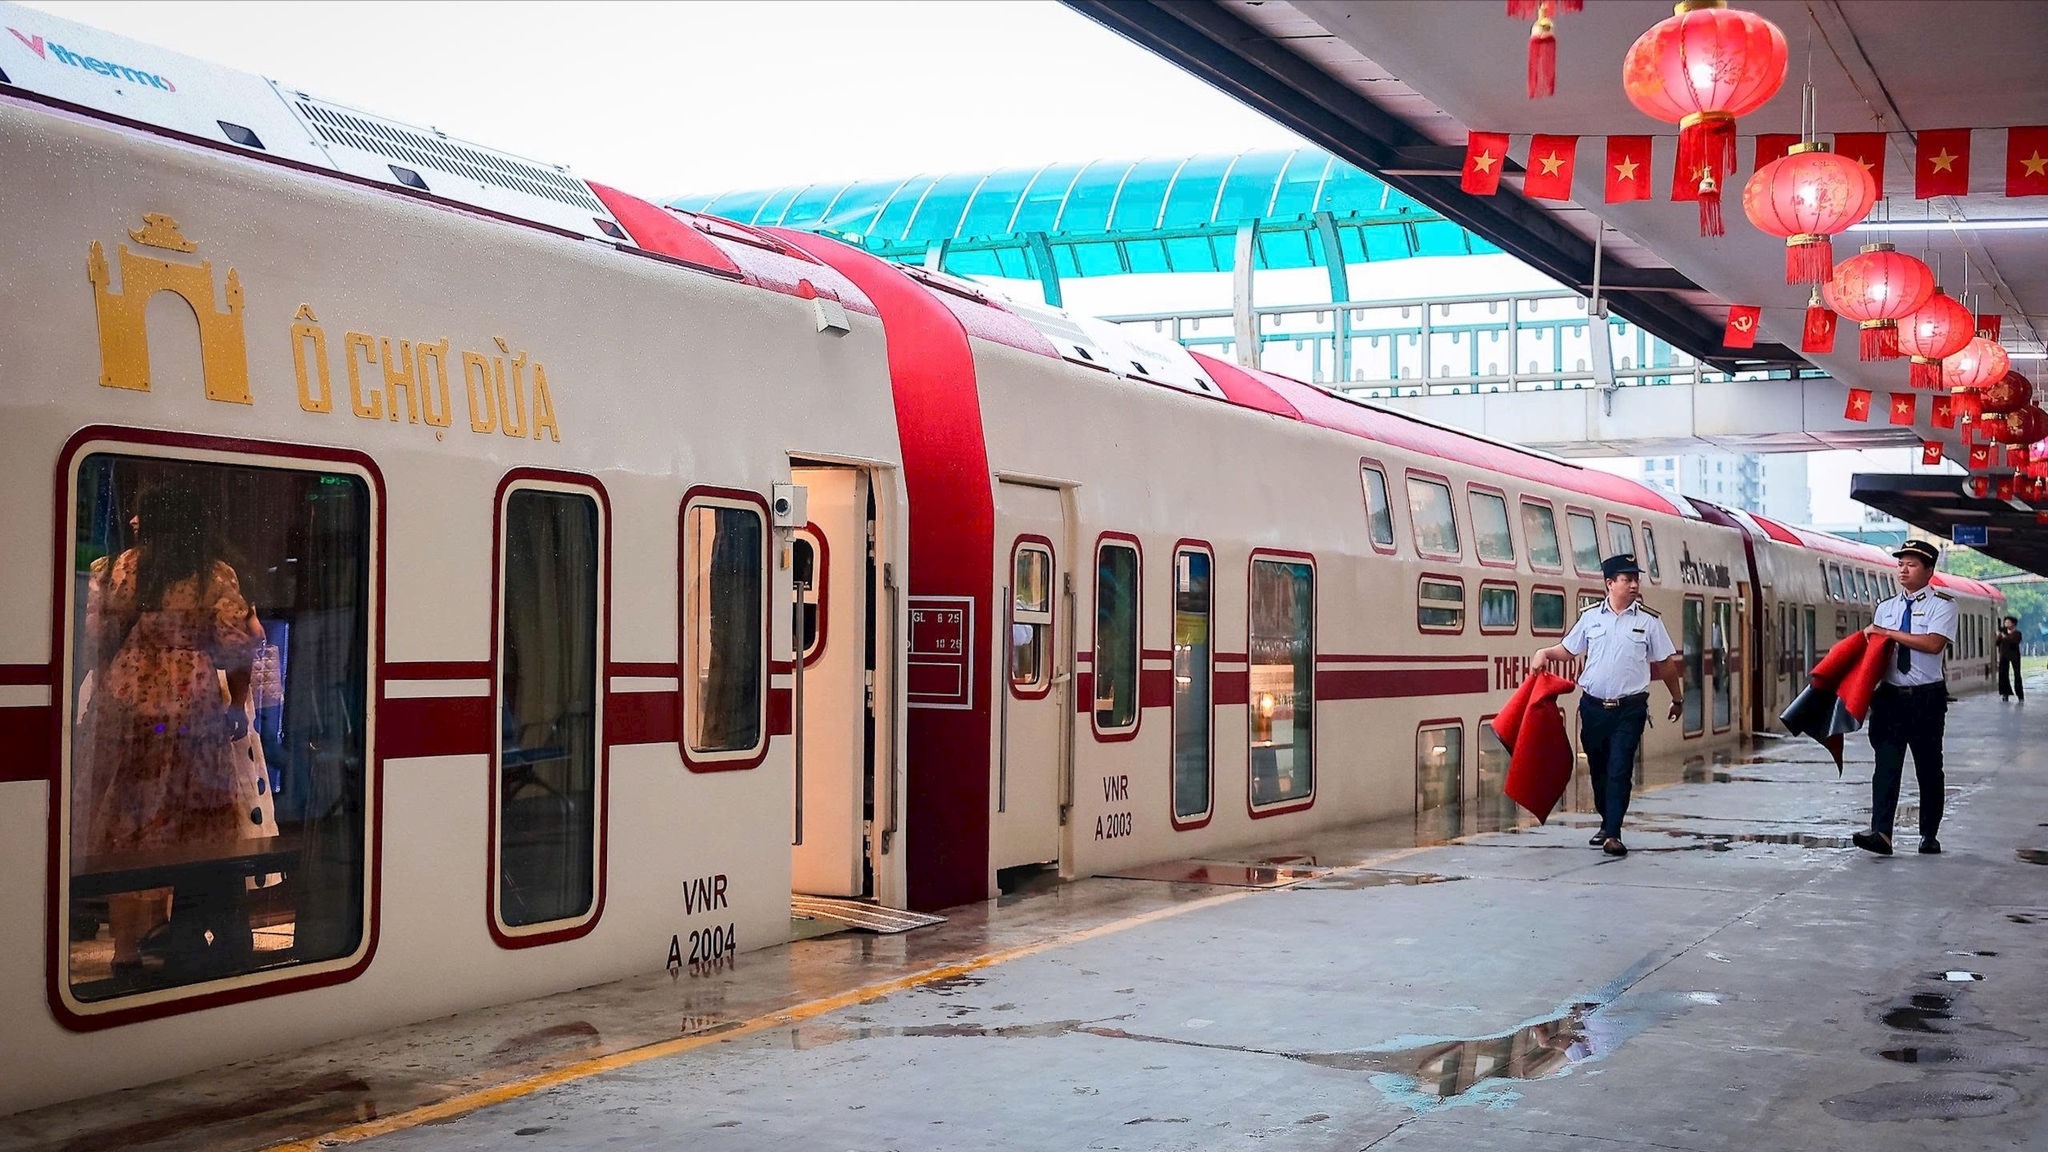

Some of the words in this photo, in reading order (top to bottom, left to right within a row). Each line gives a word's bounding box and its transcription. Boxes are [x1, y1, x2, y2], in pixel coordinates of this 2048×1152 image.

[290, 302, 333, 413] Ô
[344, 330, 453, 442] CHỢ
[462, 336, 561, 443] DỪA
[1494, 656, 1519, 690] THE
[1103, 775, 1129, 803] VNR
[1095, 815, 1104, 841] A
[1106, 811, 1132, 839] 2003
[682, 874, 728, 916] VNR
[666, 934, 683, 970] A
[688, 922, 736, 966] 2004
